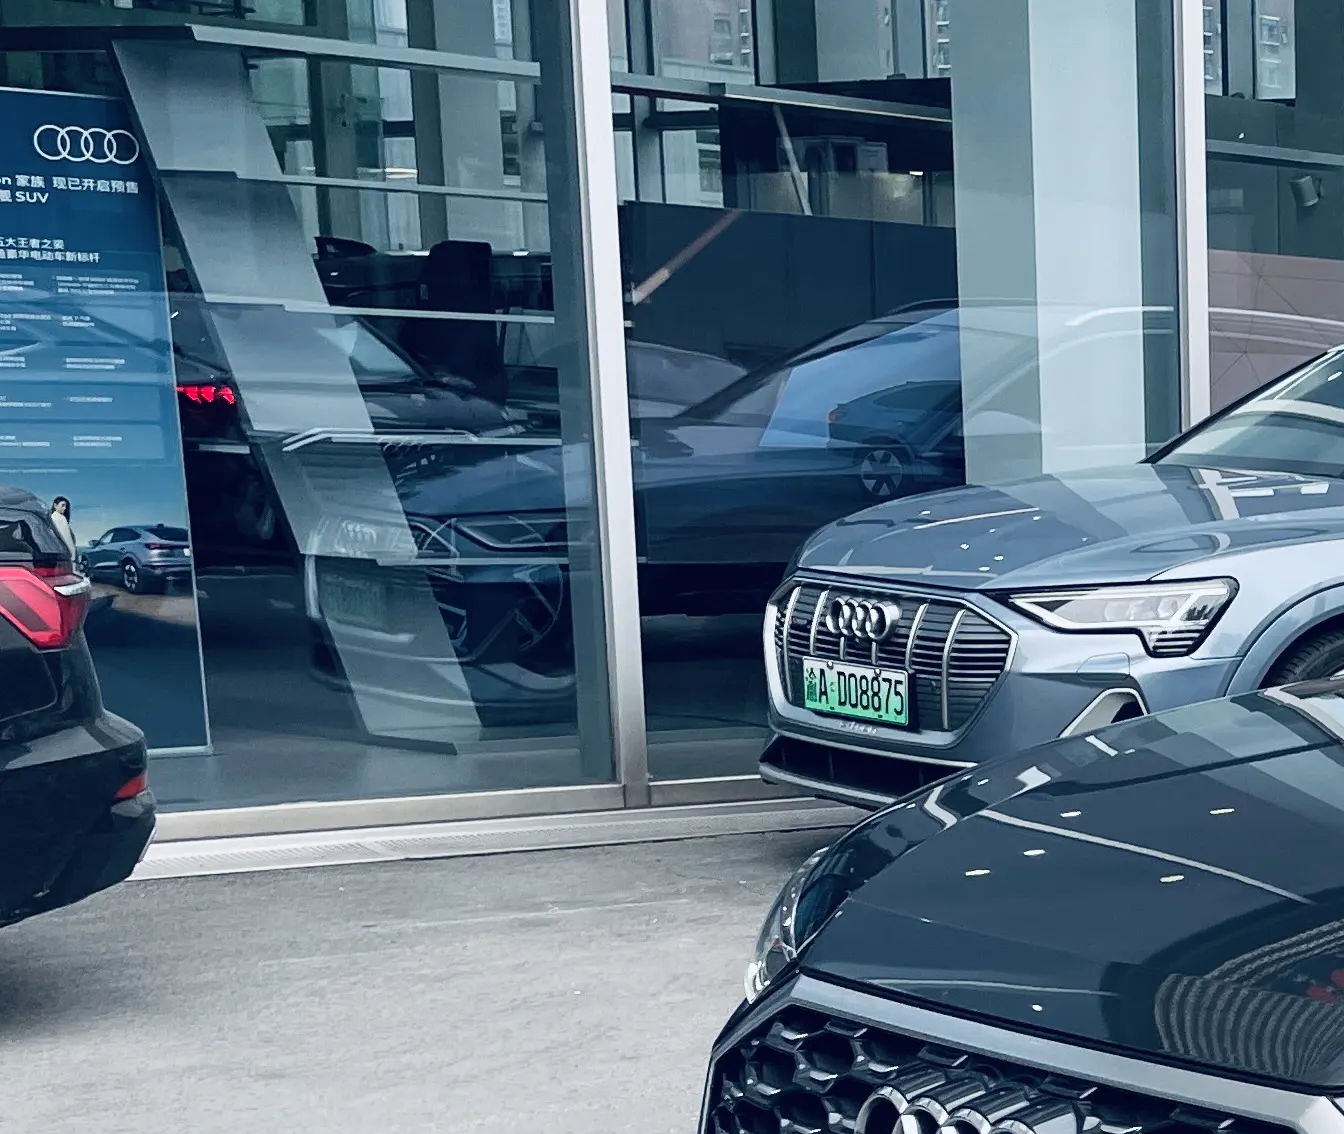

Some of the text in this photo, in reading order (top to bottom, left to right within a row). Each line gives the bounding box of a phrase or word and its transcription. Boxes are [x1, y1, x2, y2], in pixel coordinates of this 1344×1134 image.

[52, 176, 139, 194] 现已开启预售
[15, 191, 49, 203] SUV
